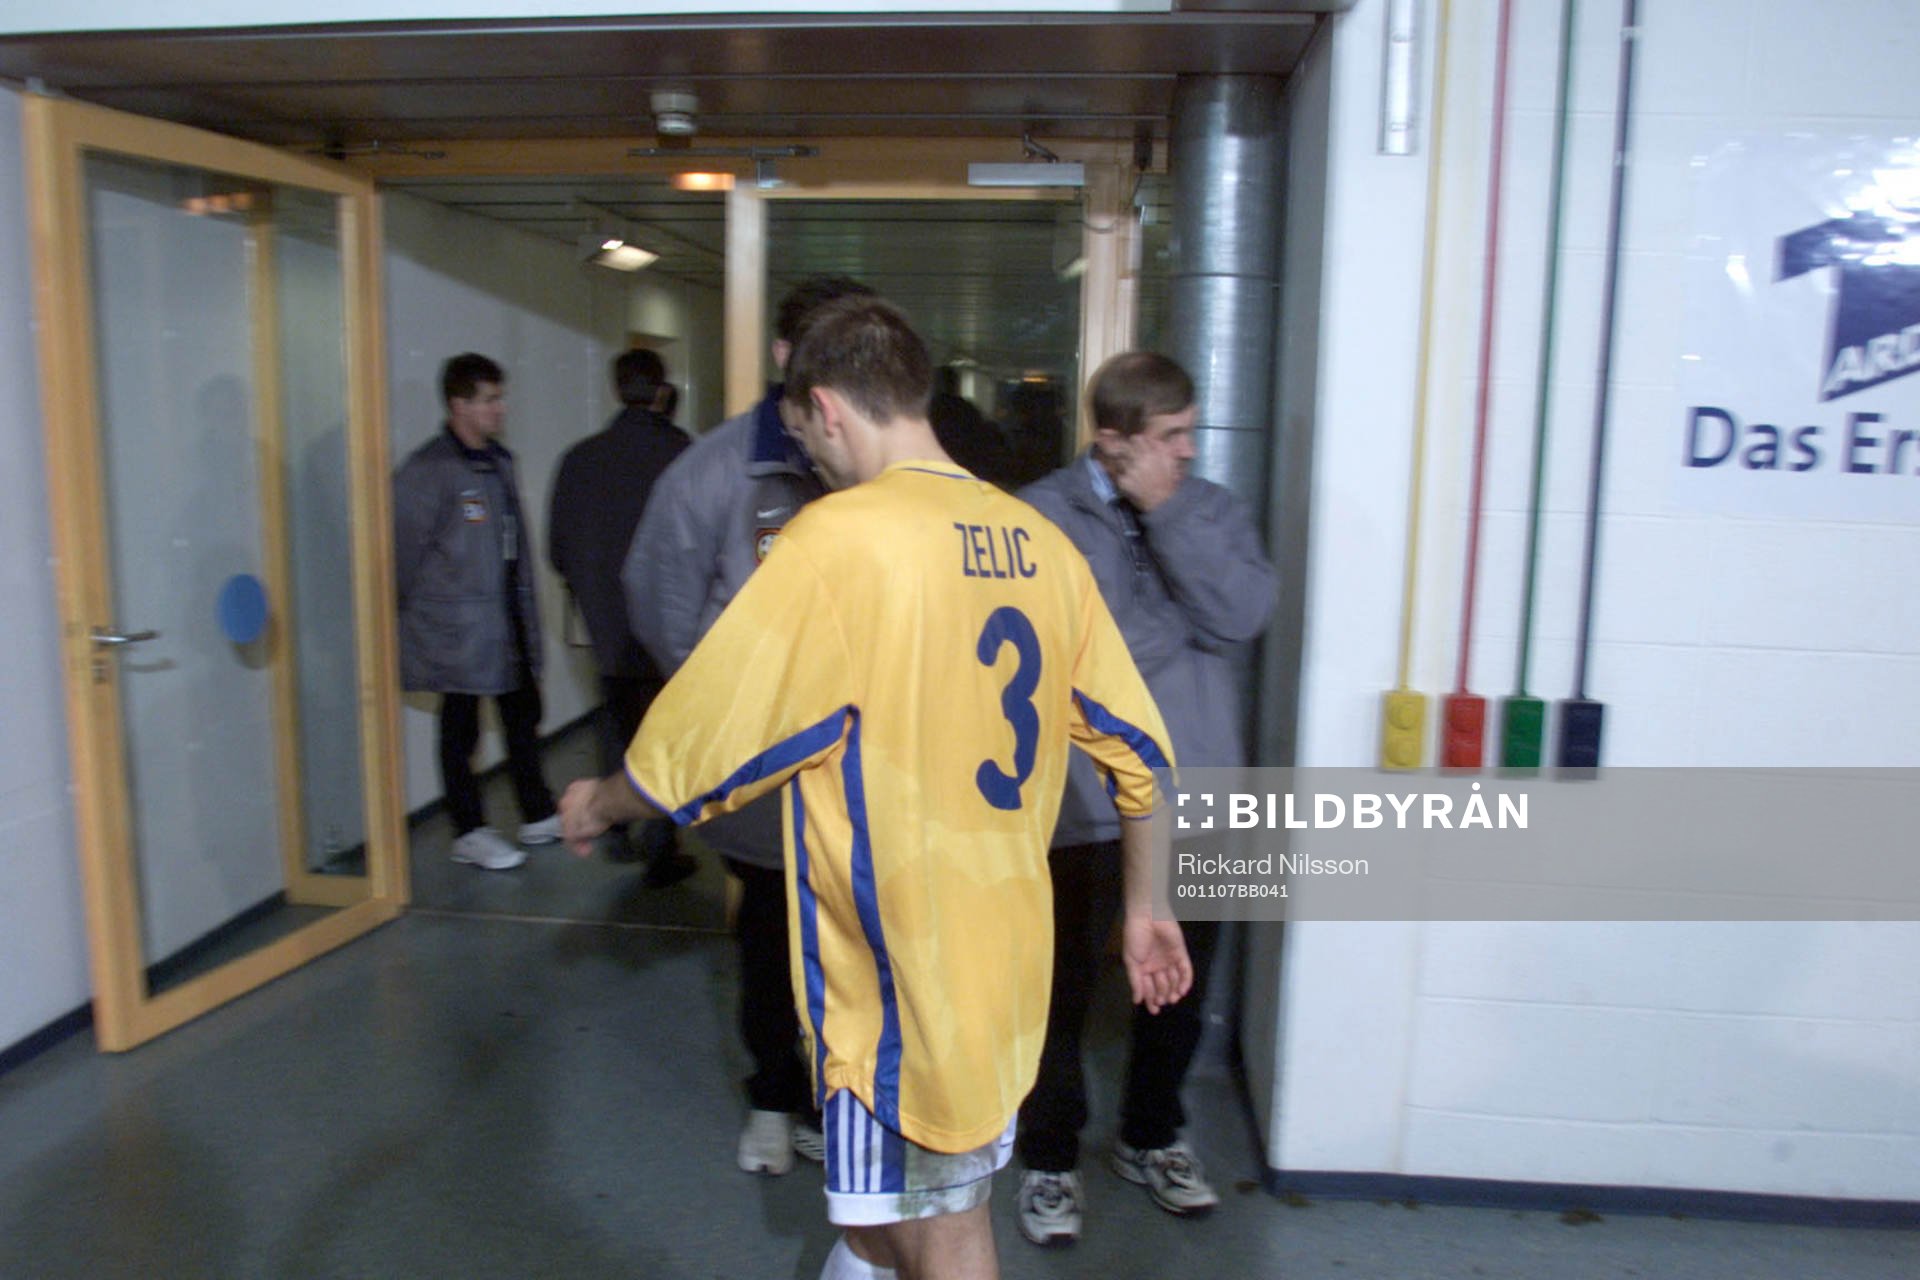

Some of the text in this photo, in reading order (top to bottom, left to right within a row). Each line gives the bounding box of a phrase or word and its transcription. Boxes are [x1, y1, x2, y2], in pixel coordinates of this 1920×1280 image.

[1681, 405, 1920, 476] Das Er
[953, 521, 1038, 579] ZELIC
[976, 605, 1043, 811] 3
